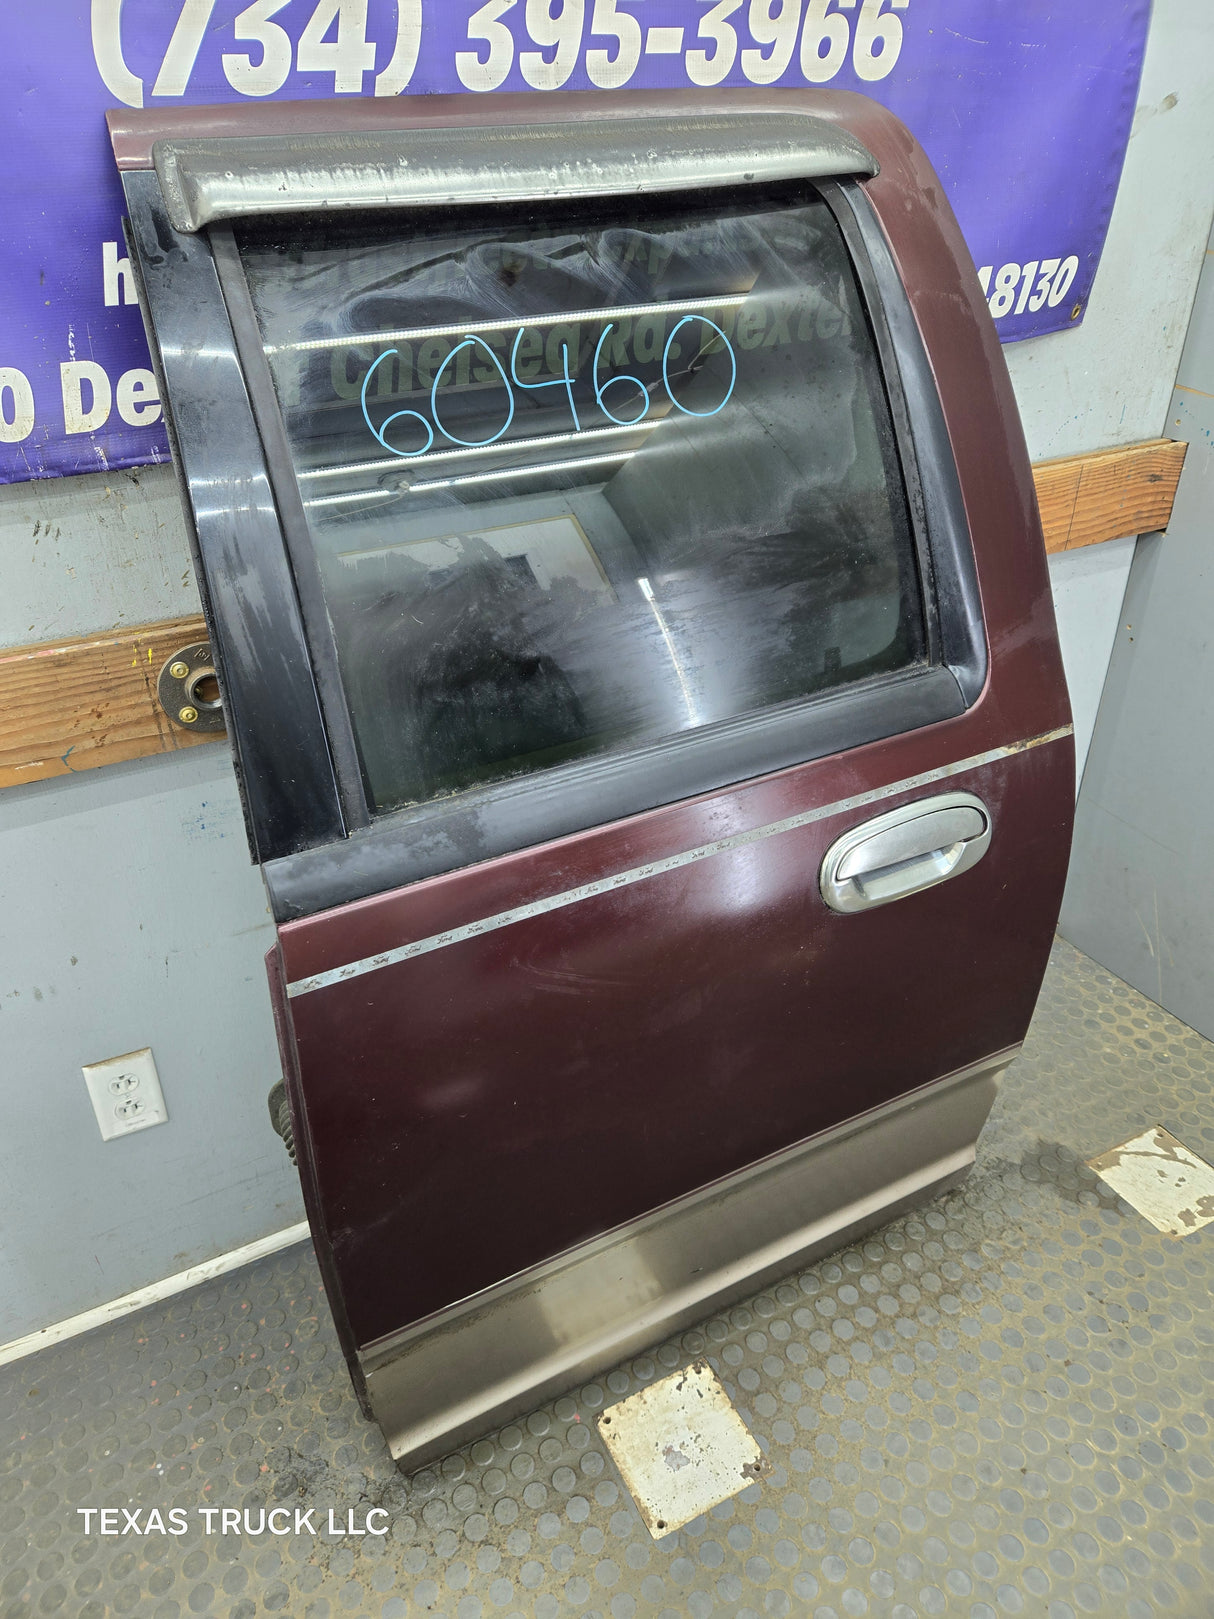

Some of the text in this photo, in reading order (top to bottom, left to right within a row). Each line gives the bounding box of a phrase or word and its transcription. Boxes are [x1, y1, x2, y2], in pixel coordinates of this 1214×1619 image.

[91, 0, 907, 108] (734) 395-3966
[60, 360, 166, 435] De
[331, 316, 580, 400] Chelsea
[362, 315, 737, 456] 60460
